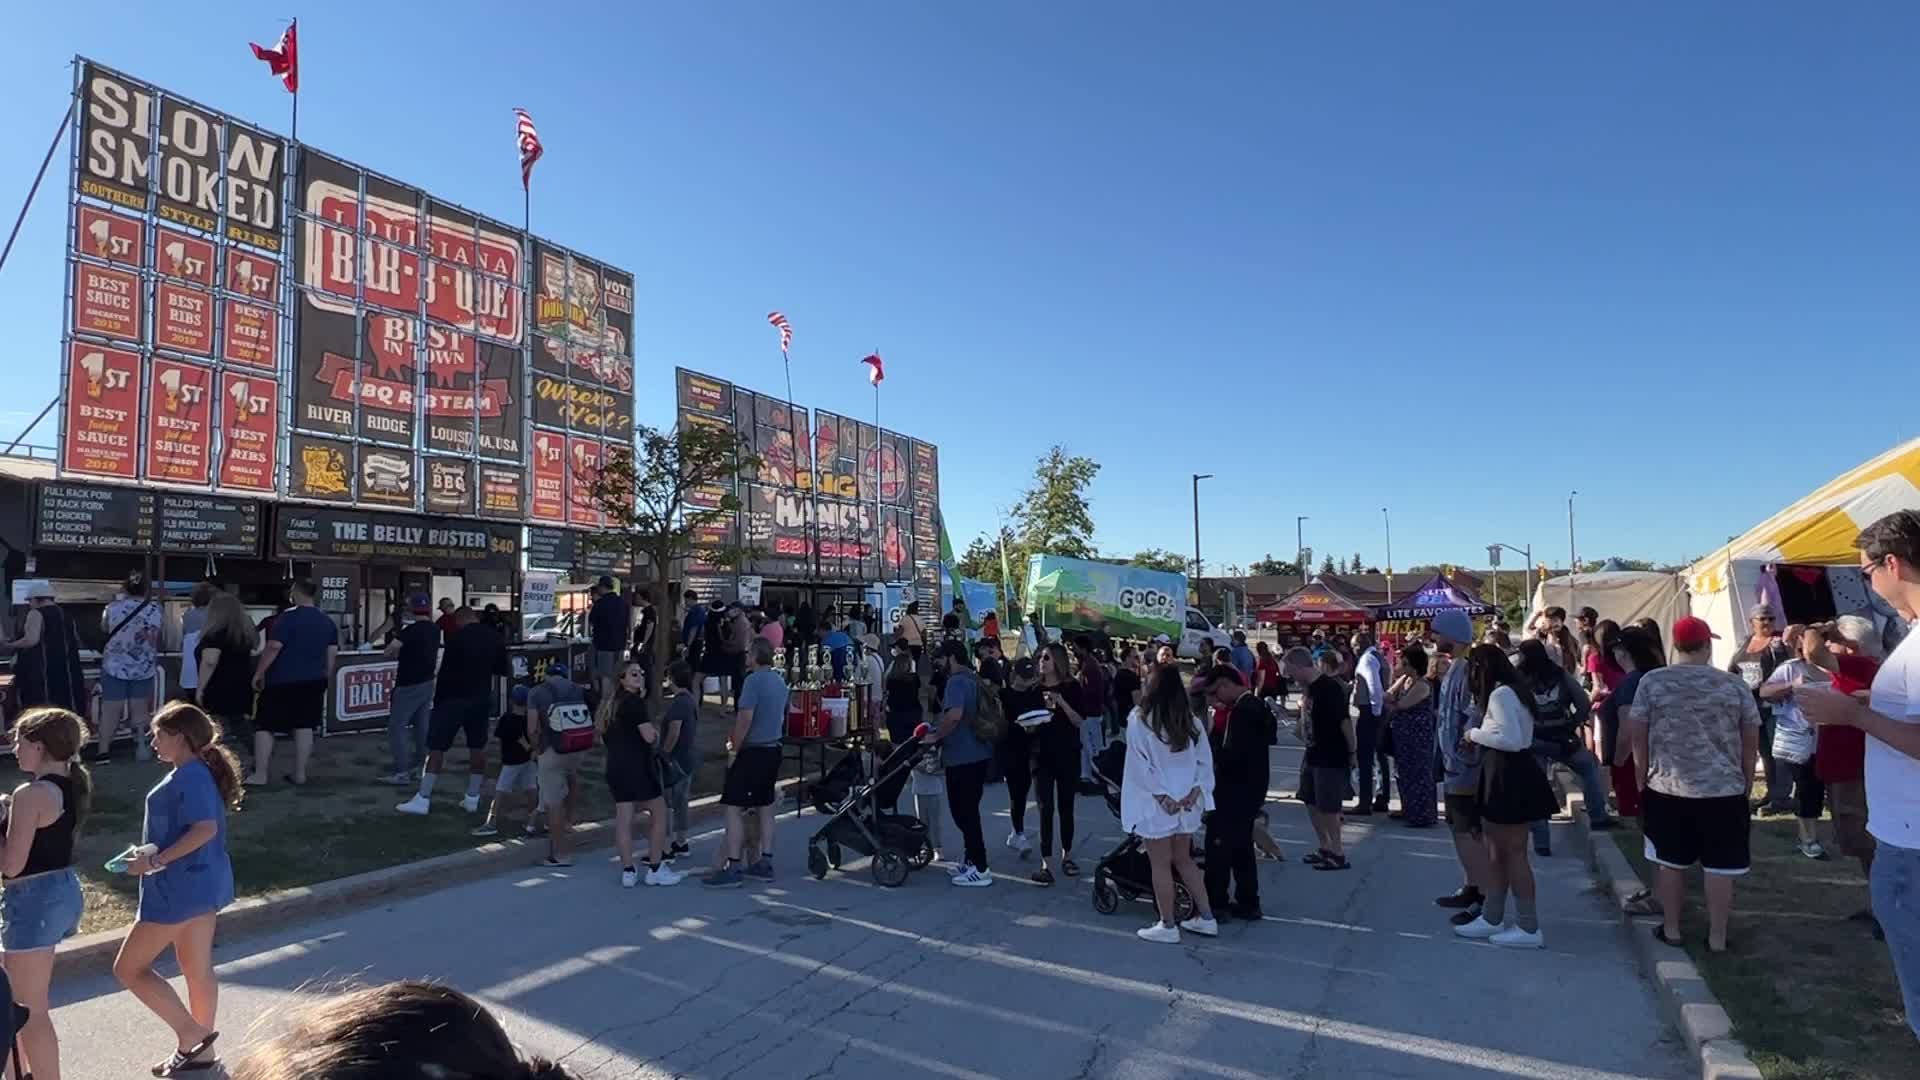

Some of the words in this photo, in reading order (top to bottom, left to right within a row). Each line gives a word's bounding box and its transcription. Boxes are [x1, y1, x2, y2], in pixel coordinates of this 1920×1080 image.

[89, 77, 278, 181] SLOW
[88, 129, 275, 229] SMOKED
[82, 180, 145, 209] SOUTHERN
[159, 204, 215, 231] STYLE
[227, 226, 278, 250] RIBS
[88, 274, 130, 294] BEST
[604, 277, 632, 299] VOTE
[86, 289, 130, 310] SAUCE
[168, 292, 204, 312] BEST
[170, 308, 201, 326] RIBS
[384, 339, 403, 356] IN
[536, 378, 617, 407] Where
[440, 395, 491, 410] TEAM
[80, 405, 128, 421] BEST
[307, 404, 352, 424] RIVER
[158, 416, 201, 432] BEST
[78, 431, 128, 447] SAUCE
[231, 429, 268, 443] BEST
[155, 440, 200, 456] SAUCE
[231, 449, 267, 462] RIBS
[43, 486, 64, 496] FULL
[432, 473, 466, 493] BBQ
[56, 499, 79, 509] RACK
[81, 501, 104, 511] PORK
[54, 534, 78, 543] RACK
[331, 521, 368, 541] THE
[374, 524, 423, 545] BELLY
[428, 528, 486, 548] BUSTER
[490, 538, 514, 554] $40
[321, 577, 348, 588] BEEF
[322, 589, 346, 600] RIBS
[1120, 589, 1167, 608] GoGo
[1386, 609, 1410, 619] LITE
